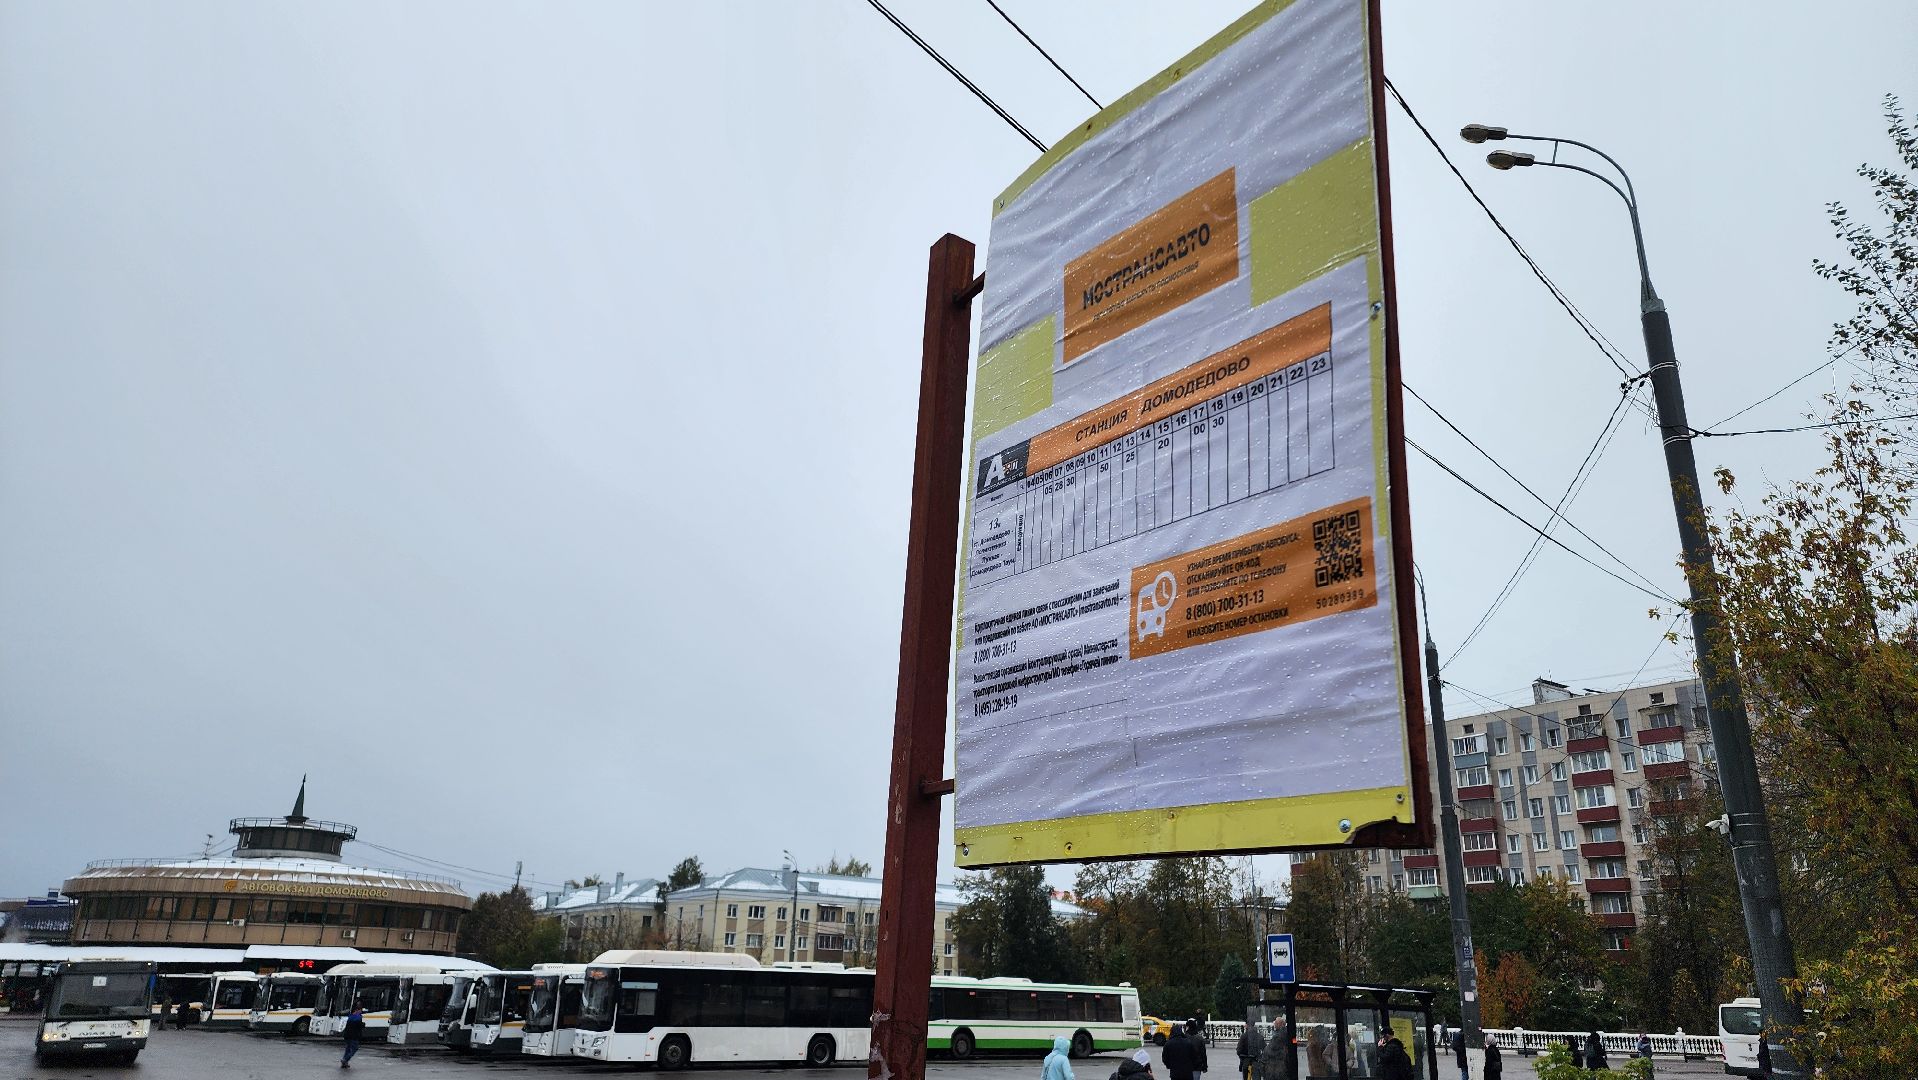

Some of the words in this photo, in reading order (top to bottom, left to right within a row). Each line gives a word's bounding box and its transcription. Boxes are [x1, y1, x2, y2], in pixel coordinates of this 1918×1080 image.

[1083, 223, 1210, 310] МОСТРАНСАВТО
[1076, 410, 1128, 442] СТАНЦИЯ
[1141, 357, 1250, 415] ДОМОДЕДОВО
[1036, 475, 1044, 484] 05
[1045, 471, 1053, 481] 06
[1055, 467, 1063, 477] 07
[1066, 462, 1075, 472] 08
[1076, 458, 1085, 468] 09
[1087, 453, 1096, 463] 10
[1100, 448, 1108, 458] 11
[1113, 443, 1122, 453] 12
[1126, 437, 1135, 447] 13
[1140, 430, 1151, 440] 14
[1158, 422, 1169, 434] 15
[1176, 414, 1187, 427] 16
[1193, 407, 1204, 420] 17
[1211, 400, 1224, 412] 18
[1231, 391, 1243, 404] 19
[1251, 383, 1263, 397] 20
[1271, 375, 1283, 388] 21
[1290, 366, 1304, 380] 22
[1311, 357, 1326, 372] 23
[1045, 485, 1053, 495] 05
[1055, 481, 1063, 491] 28
[1066, 476, 1075, 486] 30
[1100, 462, 1109, 472] 50
[1126, 451, 1135, 463] 25
[1158, 438, 1170, 449] 20
[1194, 423, 1206, 435] 00
[1212, 416, 1224, 429] 30
[1187, 558, 1211, 572] УЗНАЙТЕ
[1213, 551, 1231, 566] ВРЕМЯ
[1232, 542, 1265, 559] ПРИБЫТИЯ
[1187, 563, 1234, 585] ОТСКАНИРУЙТЕ
[1235, 557, 1261, 572] QR-КОД
[1187, 587, 1200, 598] ИЛИ
[1201, 577, 1238, 594] ПОЗВОНИТЕ
[1239, 574, 1248, 584] ПО
[1251, 563, 1287, 580] ТЕЛЕФОНУ
[1186, 607, 1192, 620] 8
[1193, 601, 1216, 620] (800)
[1219, 589, 1264, 613] 700-31-13
[1316, 589, 1365, 609] 50280389
[1192, 621, 1225, 637] НАЗОВИТЕ
[1225, 616, 1249, 632] НОМЕР
[1249, 608, 1289, 625] ОСТАНОВКИ
[241, 882, 314, 895] АВТОВОКЗАЛ
[315, 885, 389, 898] ДОМОДЕДОВО
